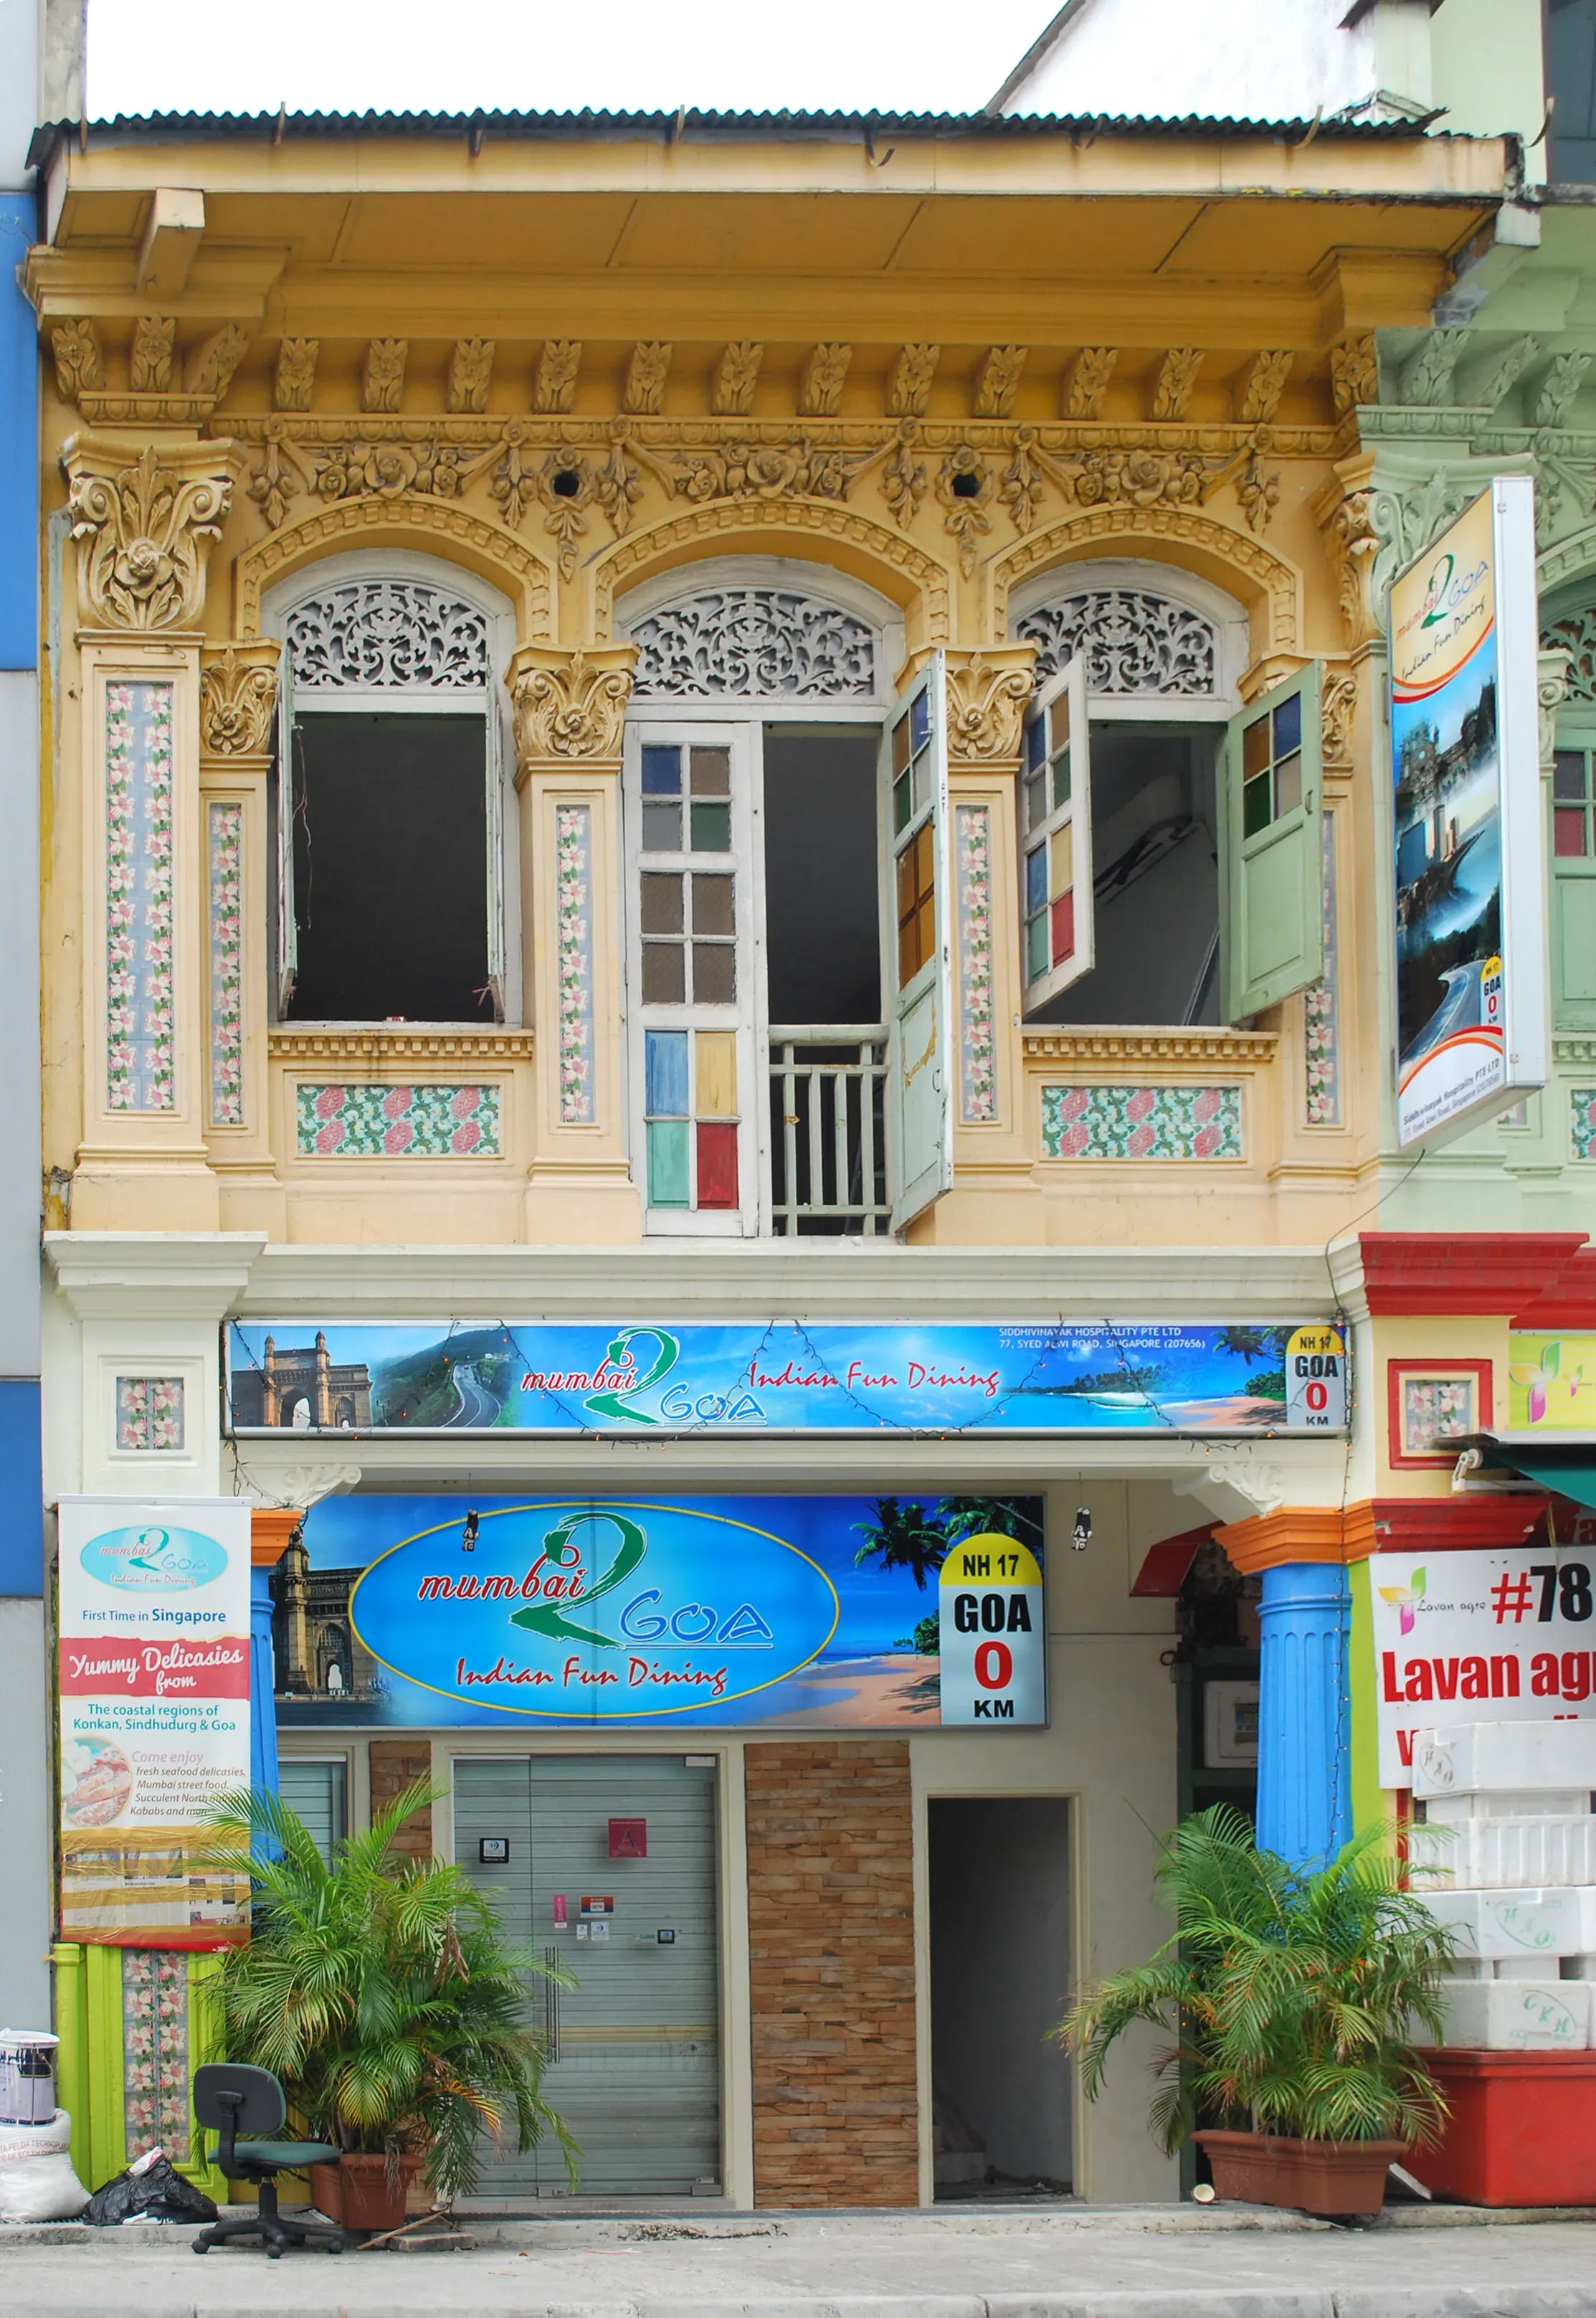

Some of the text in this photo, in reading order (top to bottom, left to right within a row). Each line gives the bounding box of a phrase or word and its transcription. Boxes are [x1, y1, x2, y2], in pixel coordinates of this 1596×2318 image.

[1448, 561, 1488, 607] GOA
[1434, 634, 1451, 654] Fun
[1454, 595, 1485, 634] Dining
[1483, 975, 1501, 996] GOA
[1475, 1065, 1487, 1082] PTE
[1488, 1058, 1500, 1074] LTD
[999, 1328, 1182, 1336] SIDDHIVINAYAK HOSPITALITY PTE LTD
[1017, 1340, 1042, 1348] SYED
[1106, 1340, 1160, 1348] SINGAPORE
[1164, 1339, 1206, 1349] (207656)
[1300, 1336, 1331, 1349] NH 17
[1295, 1356, 1339, 1378] GOA
[521, 1352, 637, 1391] mumbai
[660, 1383, 766, 1422] GOA
[750, 1361, 1000, 1397] Indian Fun Dining
[1306, 1416, 1329, 1426] KM
[100, 1538, 151, 1556] mumbai
[161, 1553, 208, 1570] GOA
[963, 1555, 1020, 1576] NH 17
[112, 1574, 196, 1587] Indian Fun Dining
[419, 1544, 586, 1600] mumbai
[619, 1588, 774, 1642] GOA
[954, 1594, 1032, 1633] GOA
[1417, 1599, 1454, 1611] Lavan
[82, 1608, 226, 1624] First Time in Singapore
[70, 1642, 244, 1684] Yummy Delicasies
[156, 1670, 196, 1695] from
[456, 1657, 728, 1695] Indian Fun Dining
[1382, 1651, 1596, 1702] Lavan ag
[87, 1703, 219, 1718] The coastal regions of
[974, 1700, 1014, 1718] KM
[74, 1718, 236, 1733] Konkan, Sindhudurg & Goa
[132, 1751, 204, 1765] Come enjoy
[136, 1766, 246, 1777] fresh seafood delicasies,
[138, 1780, 176, 1789] Mumbai
[135, 1793, 179, 1802] Succulent
[182, 1794, 208, 1802] North
[130, 1807, 164, 1815] Kababs
